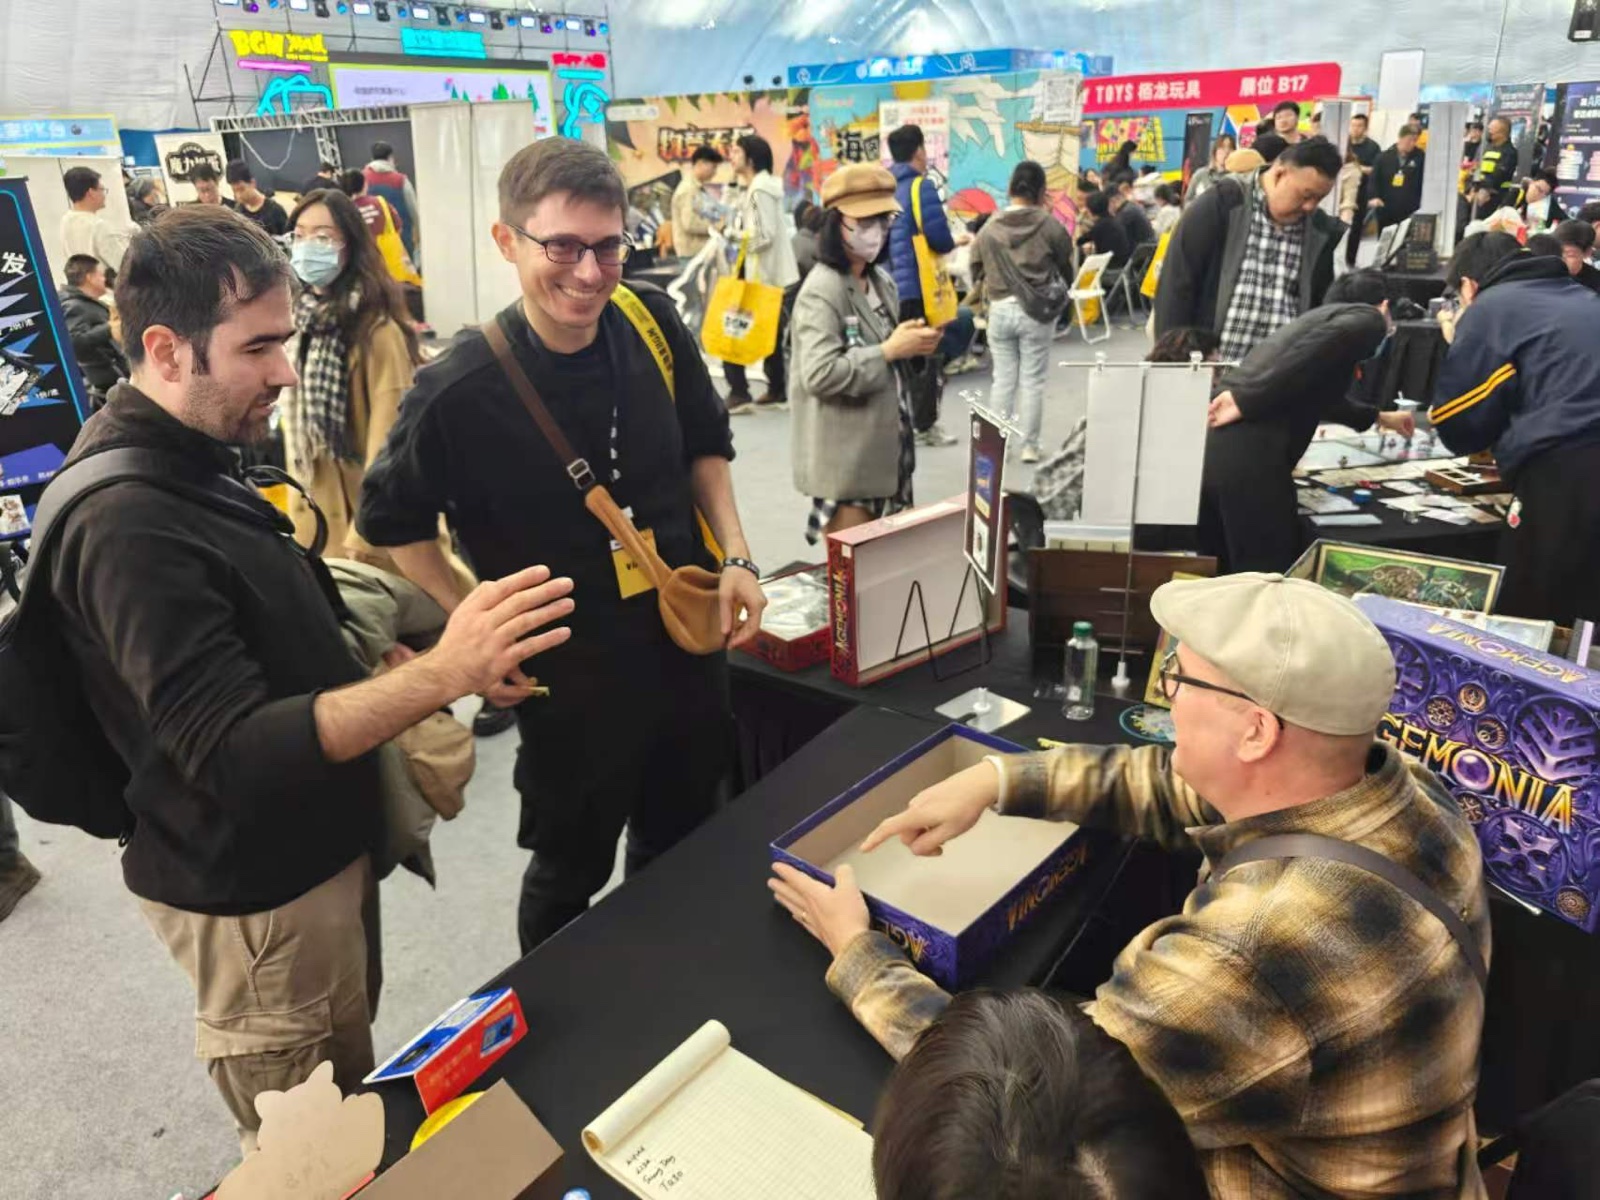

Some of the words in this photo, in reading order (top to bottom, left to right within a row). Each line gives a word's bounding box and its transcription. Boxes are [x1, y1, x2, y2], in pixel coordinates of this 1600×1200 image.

[1096, 82, 1132, 103] TOYS
[1240, 76, 1274, 98] 展位
[1278, 74, 1308, 93] B17
[1427, 622, 1590, 684] AGEMONIA
[1376, 712, 1578, 834] GEMONIA
